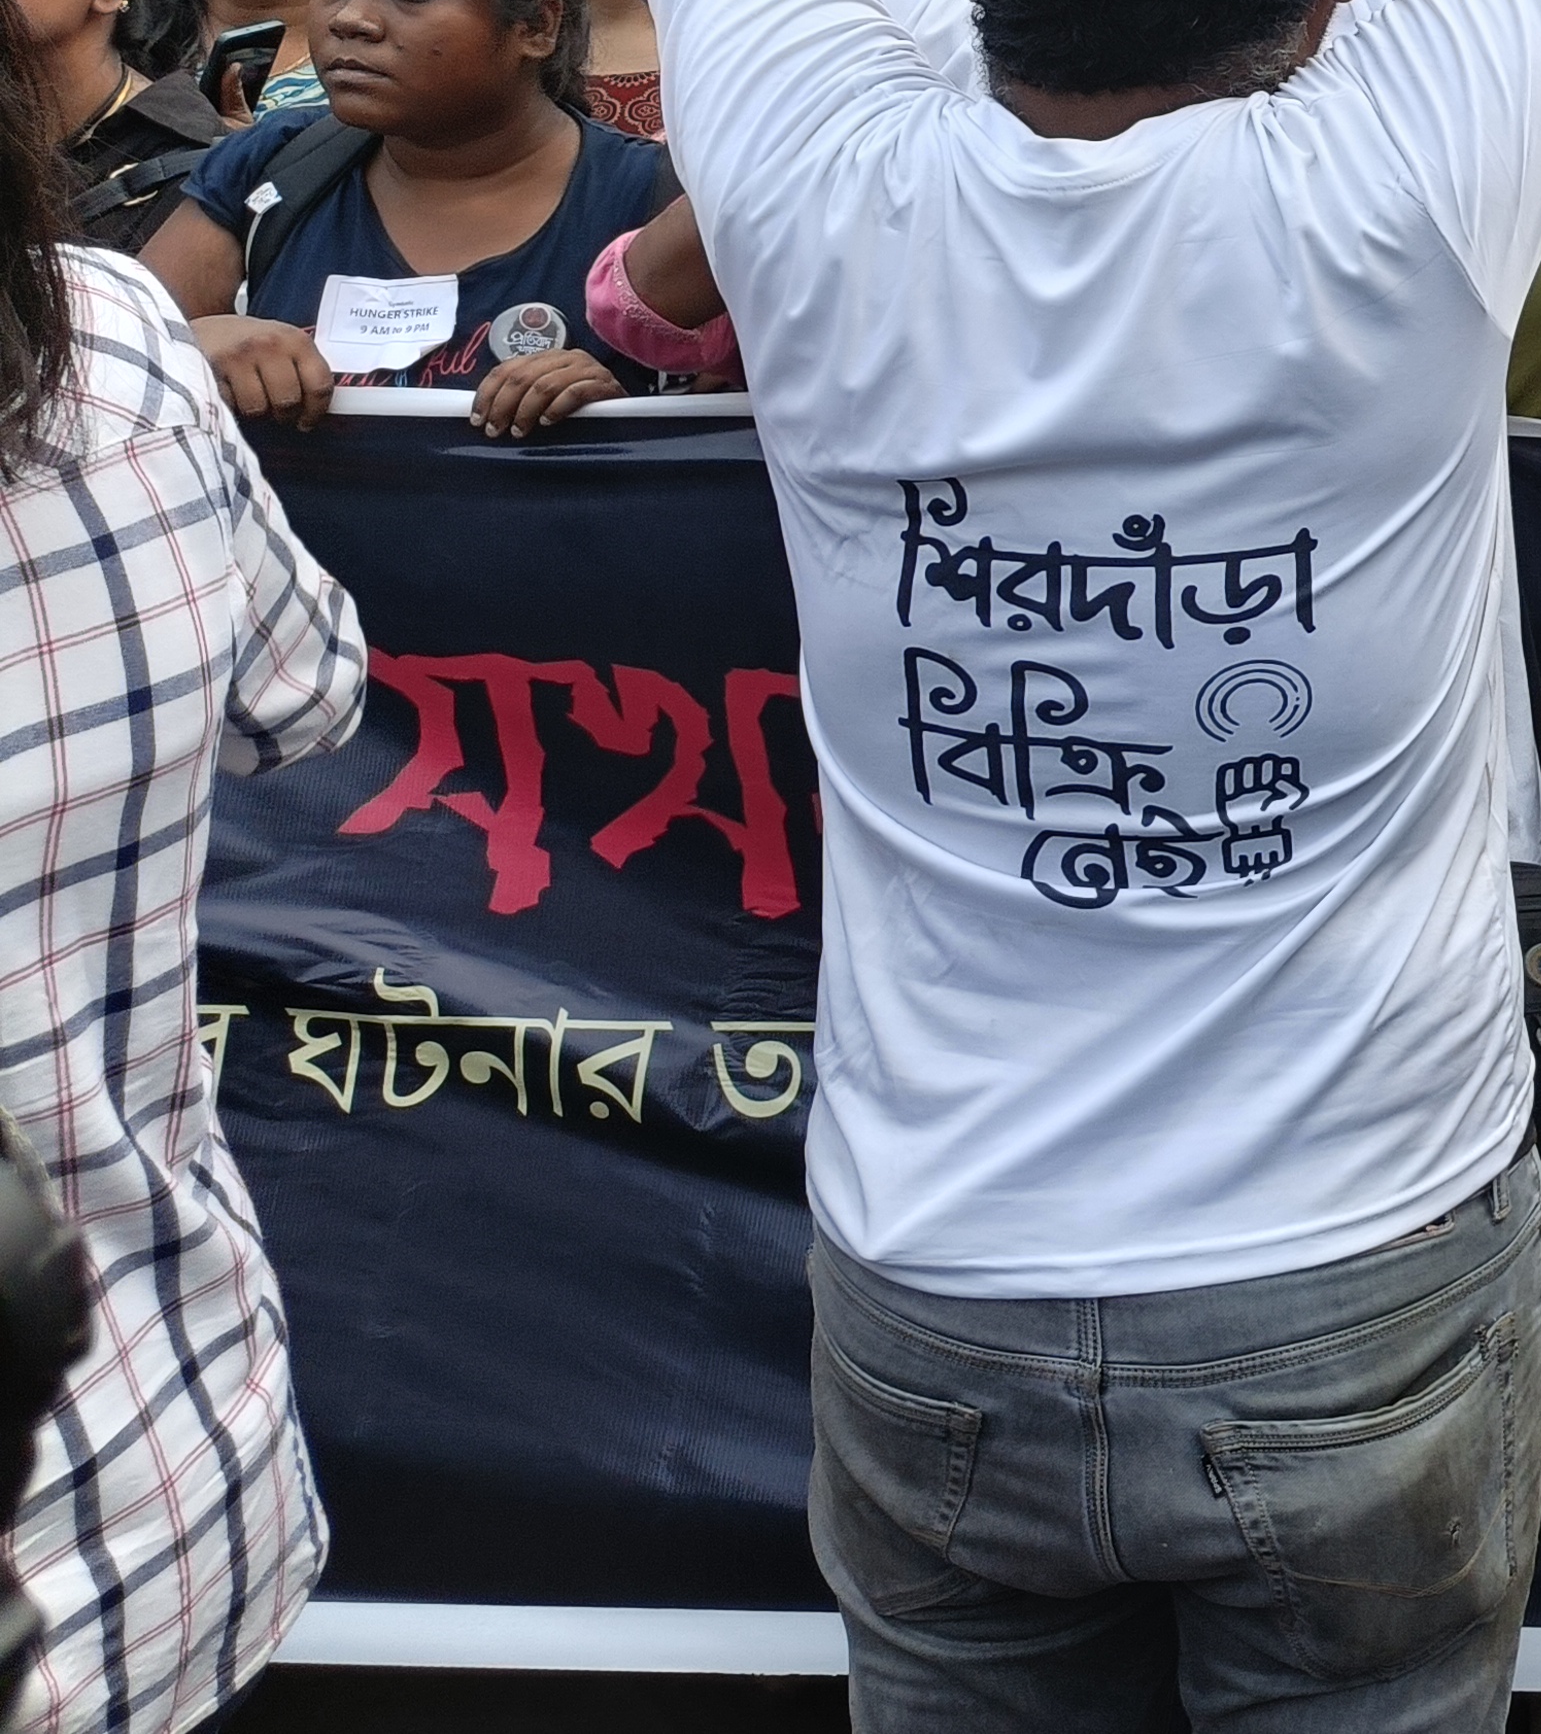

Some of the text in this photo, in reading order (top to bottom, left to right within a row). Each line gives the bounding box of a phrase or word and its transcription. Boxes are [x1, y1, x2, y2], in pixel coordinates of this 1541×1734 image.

[349, 306, 439, 319] HUNGER STRIKE
[360, 325, 367, 334] 9
[370, 326, 390, 335] AM
[413, 323, 430, 333] PM
[896, 476, 1318, 650] শিরদাঁড়া
[898, 646, 1174, 821] বিক্রি
[284, 966, 674, 1123] ঘটনার
